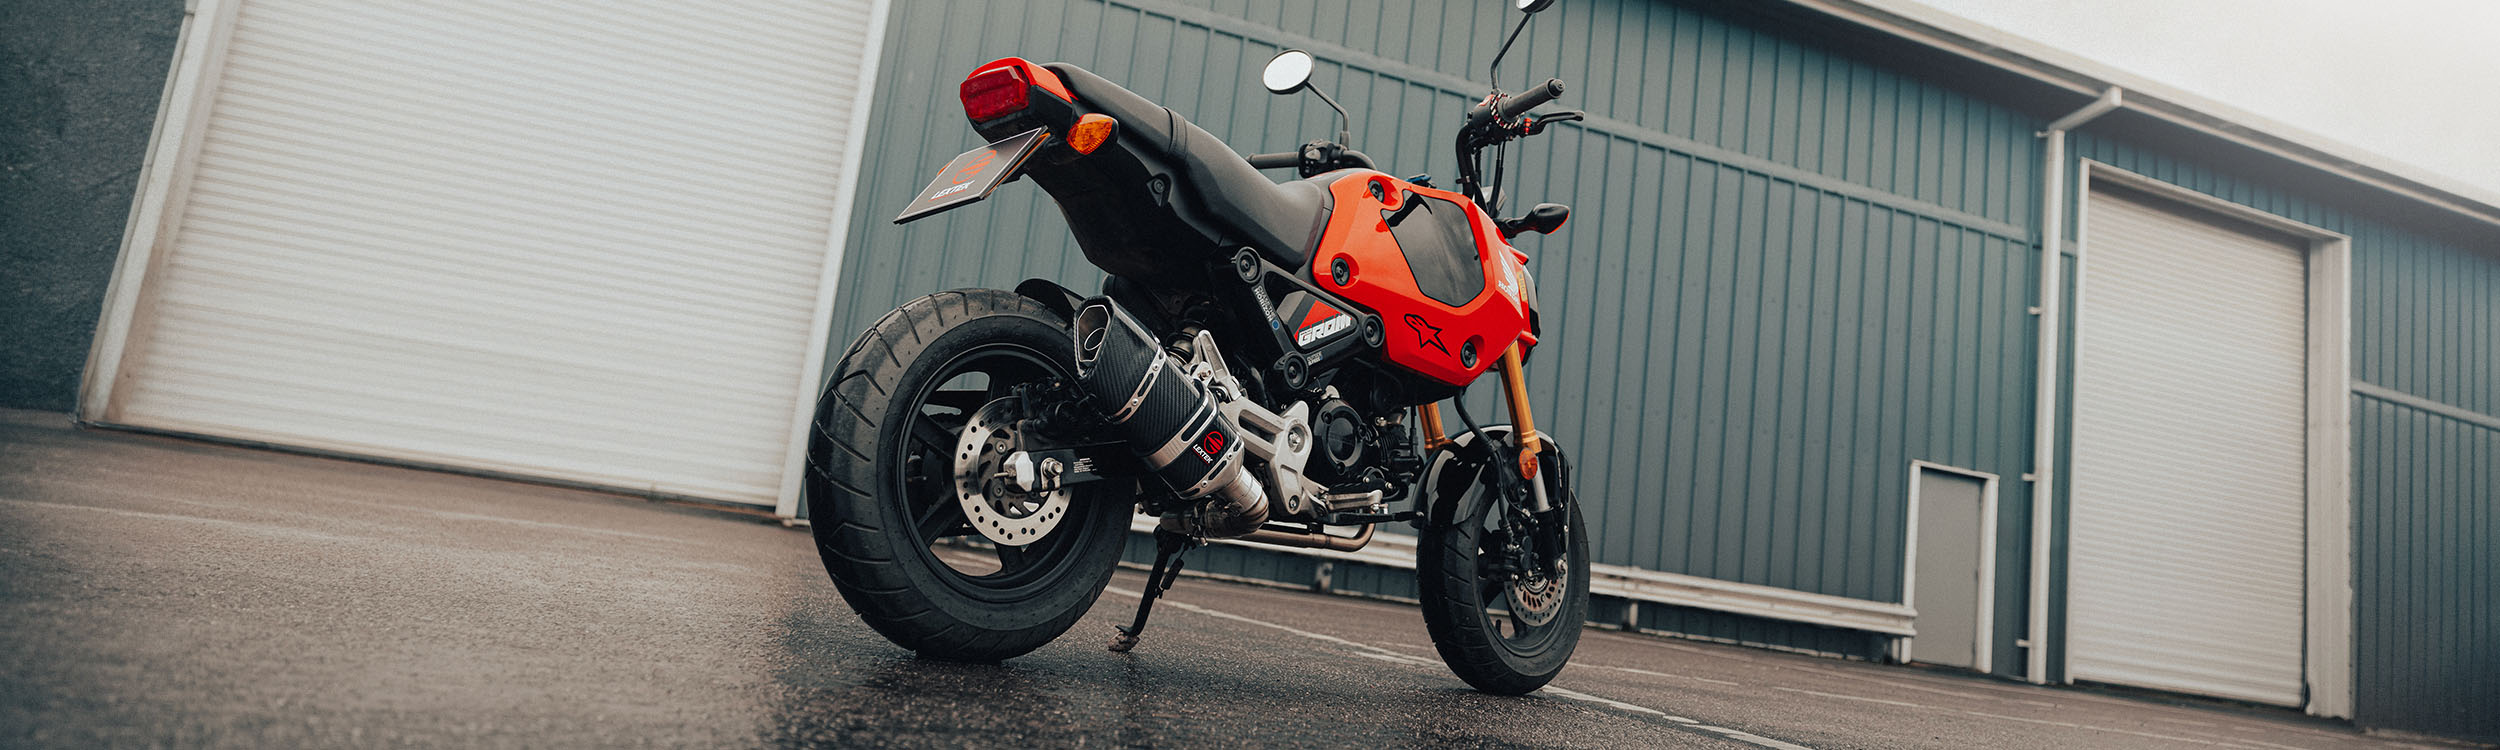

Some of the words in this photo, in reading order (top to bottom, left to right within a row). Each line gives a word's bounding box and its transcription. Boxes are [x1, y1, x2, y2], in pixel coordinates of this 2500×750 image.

[931, 180, 976, 200] LEXTEK
[1254, 287, 1273, 322] HORIZON
[1298, 314, 1351, 347] GROM
[1193, 443, 1213, 464] LEXTEK
